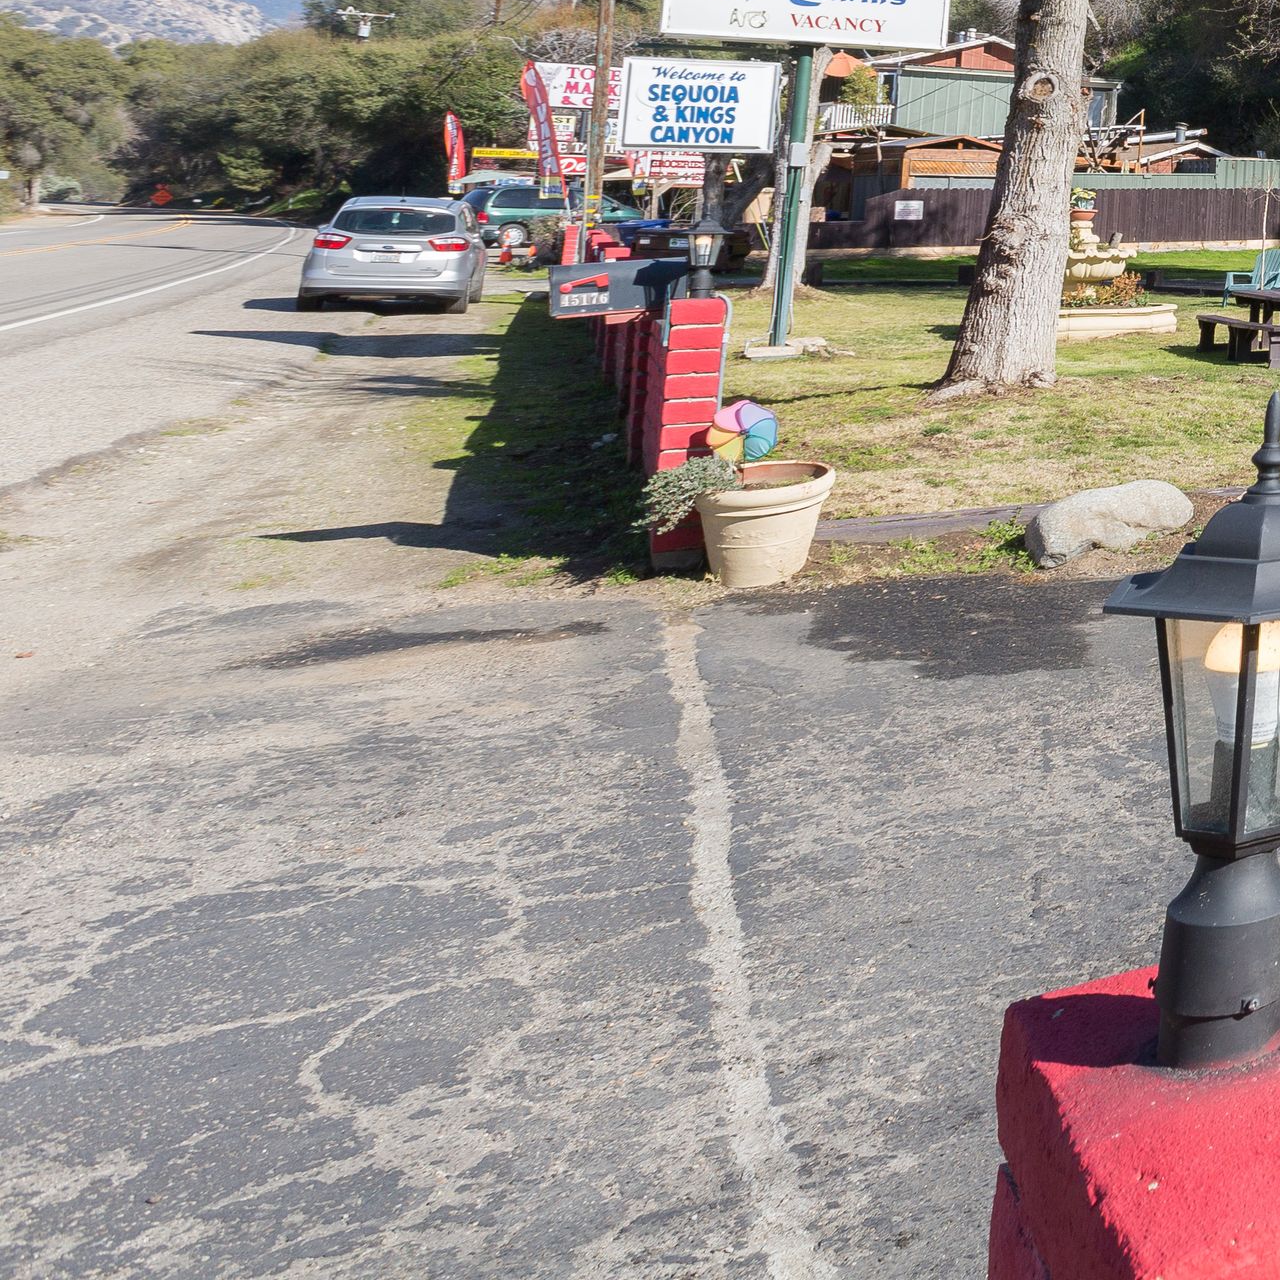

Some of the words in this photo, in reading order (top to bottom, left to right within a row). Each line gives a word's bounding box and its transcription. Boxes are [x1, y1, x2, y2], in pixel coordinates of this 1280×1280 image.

[791, 13, 887, 33] VACANCY
[651, 66, 726, 81] Welcome
[728, 70, 747, 82] to
[648, 84, 739, 106] SEQUOIA
[652, 105, 670, 122] &
[675, 106, 736, 125] KINGS
[650, 126, 734, 145] CANYON
[561, 292, 609, 307] 45176
